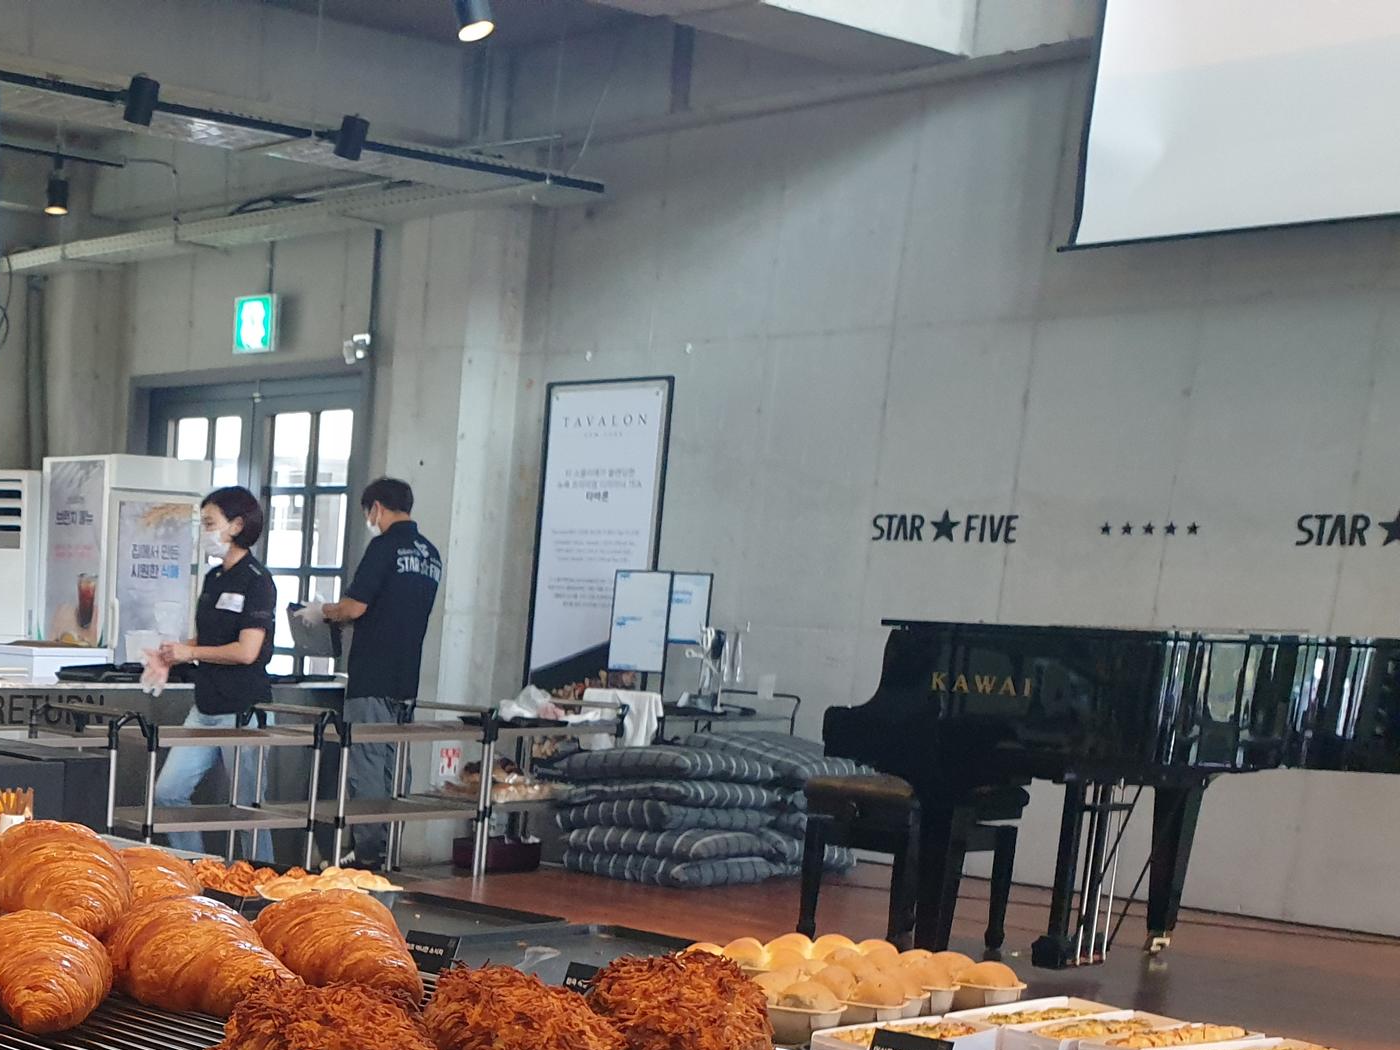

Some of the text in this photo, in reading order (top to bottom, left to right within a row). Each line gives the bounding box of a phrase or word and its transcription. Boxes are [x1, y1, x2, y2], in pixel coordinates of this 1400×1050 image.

[561, 413, 648, 428] TAVALON
[871, 514, 1019, 544] STAR FIVE
[1295, 513, 1371, 547] STAR
[130, 563, 160, 579] 시원한
[930, 671, 1033, 697] KAWAI
